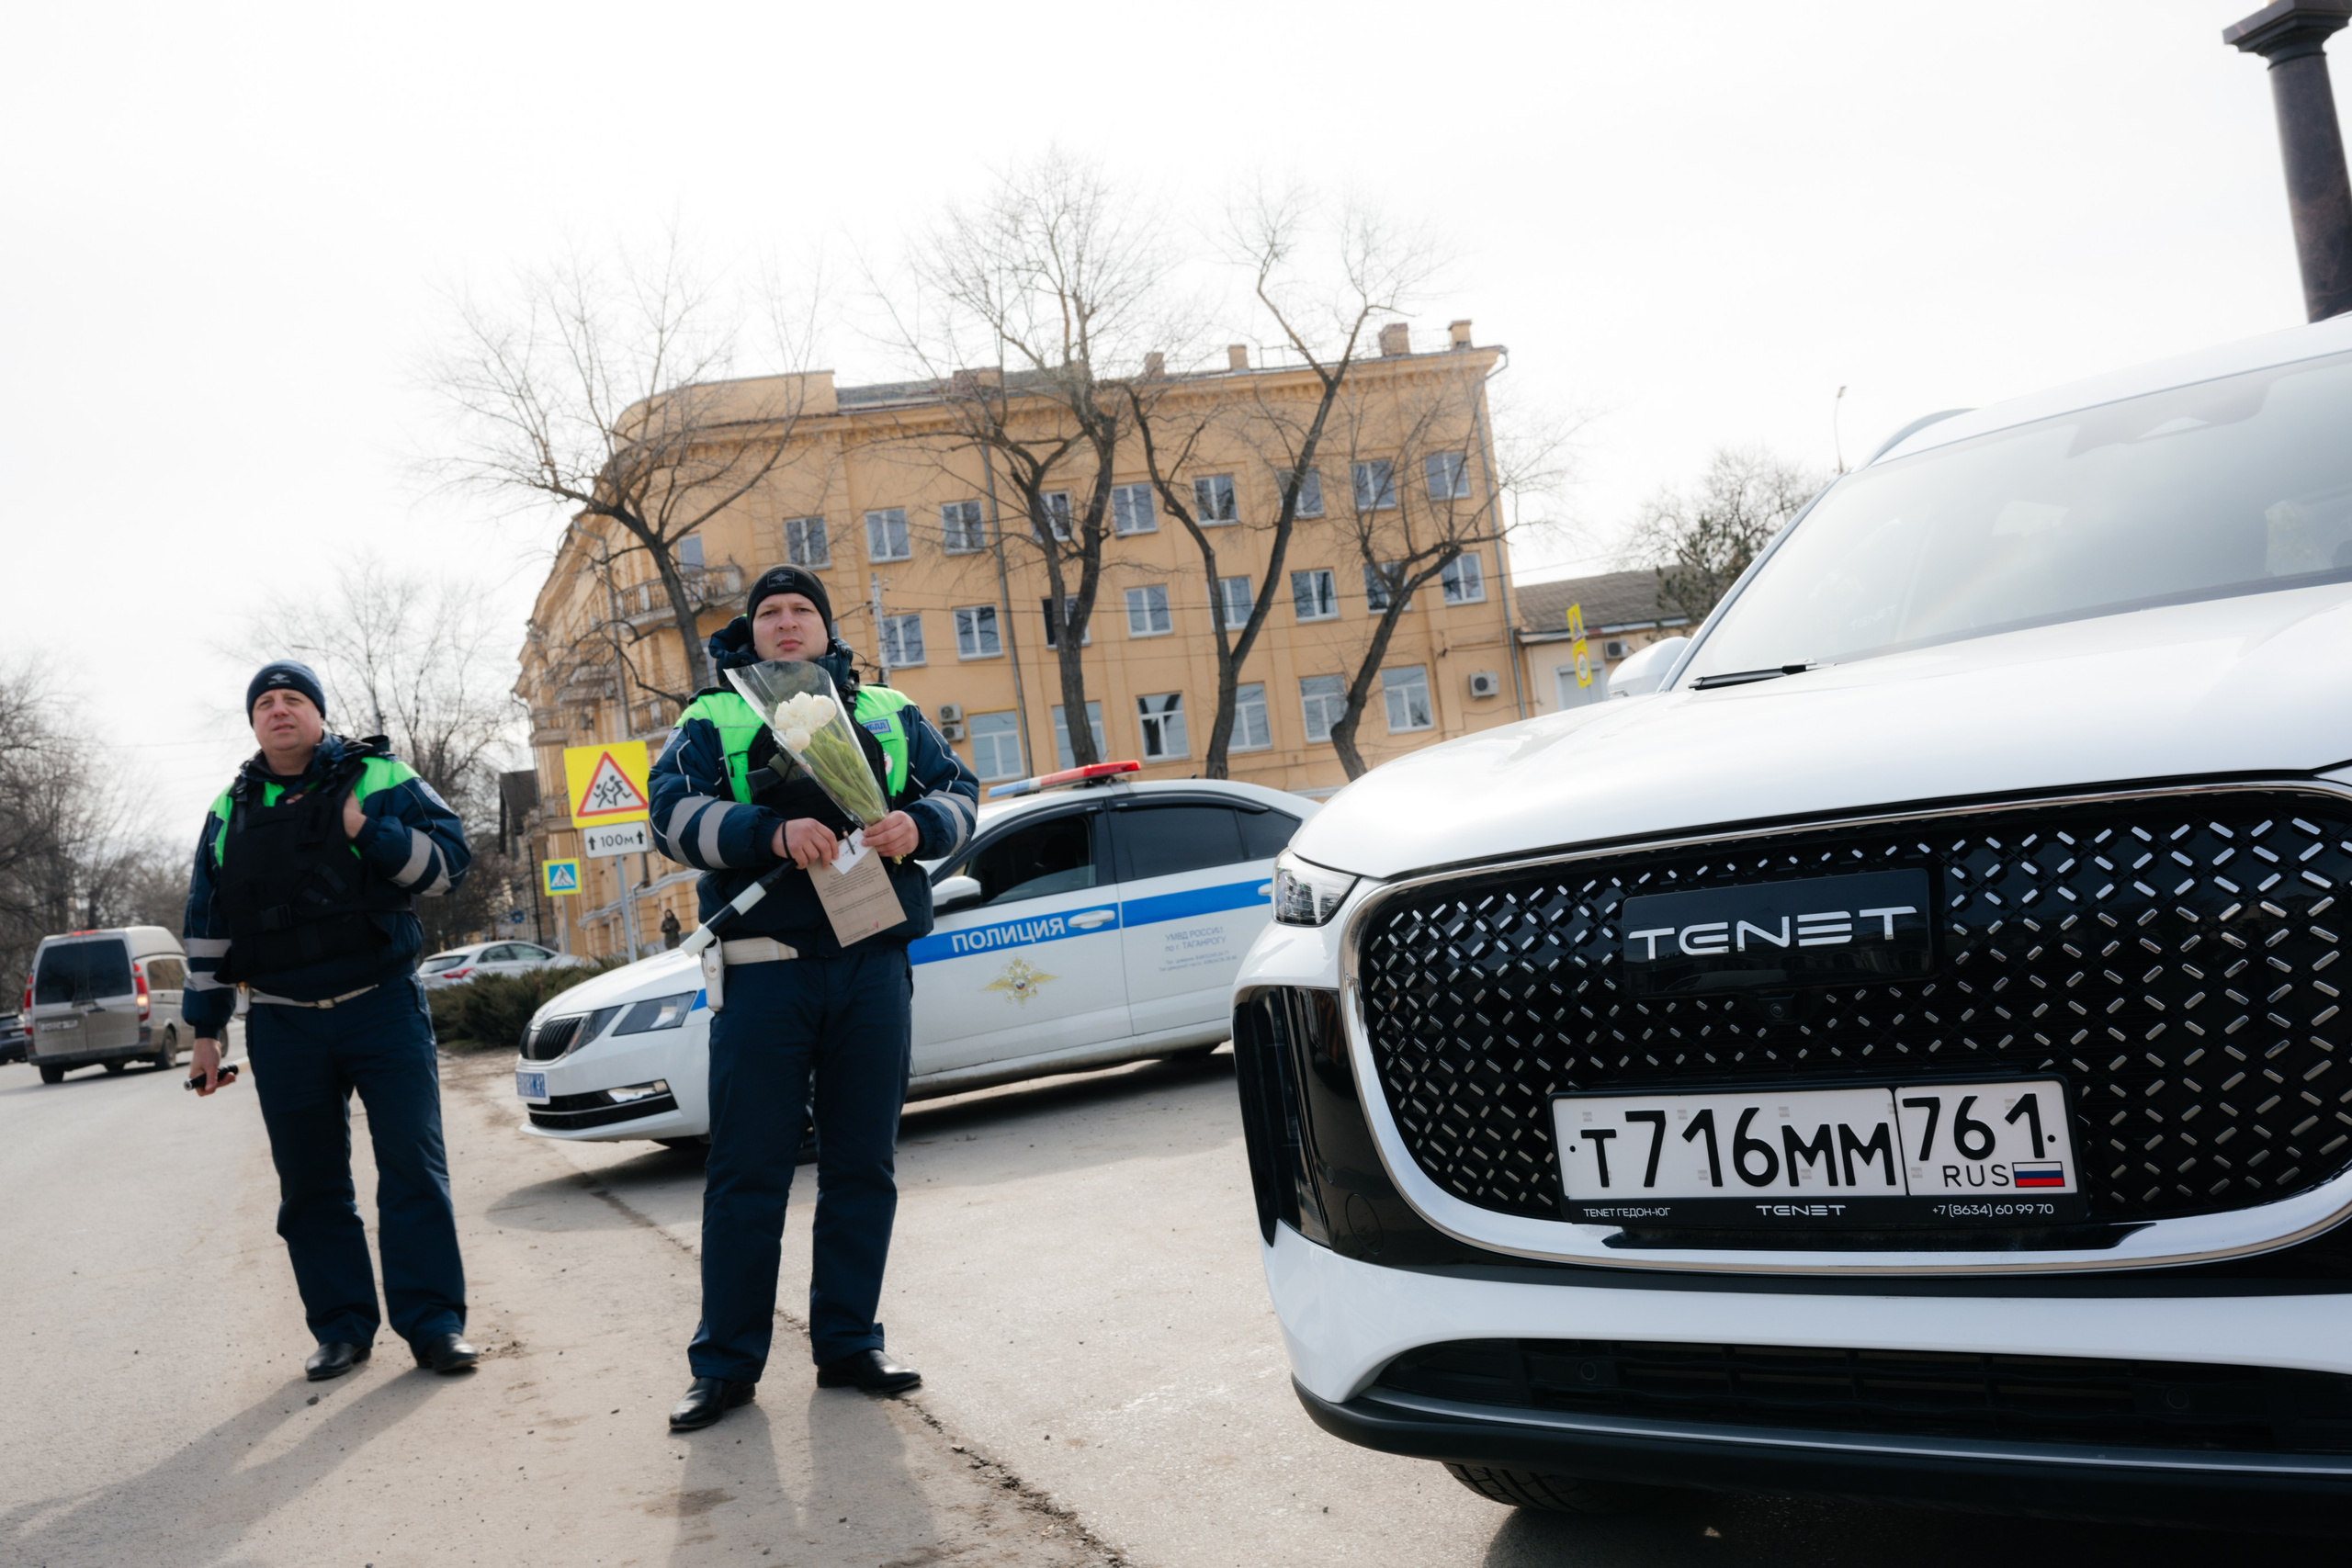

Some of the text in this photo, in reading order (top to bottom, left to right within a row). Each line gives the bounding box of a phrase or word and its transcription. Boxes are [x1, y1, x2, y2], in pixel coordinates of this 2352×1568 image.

[951, 917, 1066, 953] ПОЛИЦИЯ
[1164, 931, 1189, 942] УМВД
[1628, 905, 1917, 960] TENET
[1182, 936, 1227, 950] ТАГАНРОГУ
[1902, 1093, 2047, 1161] 761
[1942, 1164, 2010, 1188] RUS
[1583, 1207, 1671, 1219] TENET ГЕДОН-ЮГ
[1756, 1204, 1847, 1216] TENET
[1932, 1205, 1947, 1215] +7
[1995, 1204, 2014, 1215] 60
[2016, 1203, 2034, 1214] 99
[2036, 1203, 2054, 1214] 70
